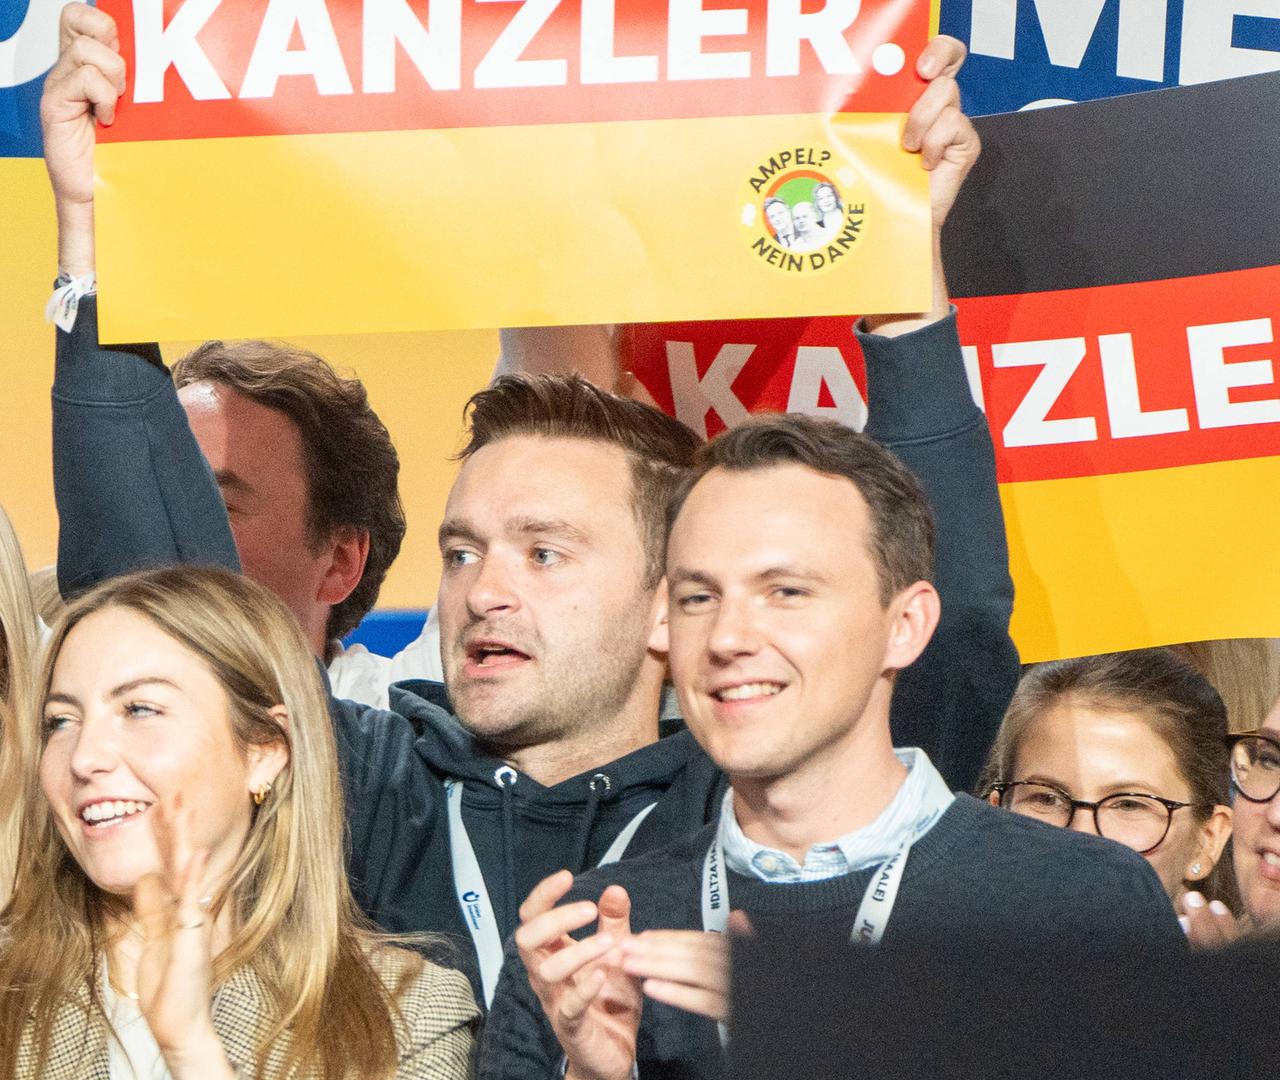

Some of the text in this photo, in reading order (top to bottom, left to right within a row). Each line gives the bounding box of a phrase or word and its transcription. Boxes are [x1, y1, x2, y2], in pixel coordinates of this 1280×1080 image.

[131, 0, 906, 104] KANZLER.
[748, 147, 832, 194] AMPEL?
[751, 202, 865, 273] NEIN DANKE
[665, 317, 1280, 449] KAZLE
[709, 864, 721, 910] #DLT24
